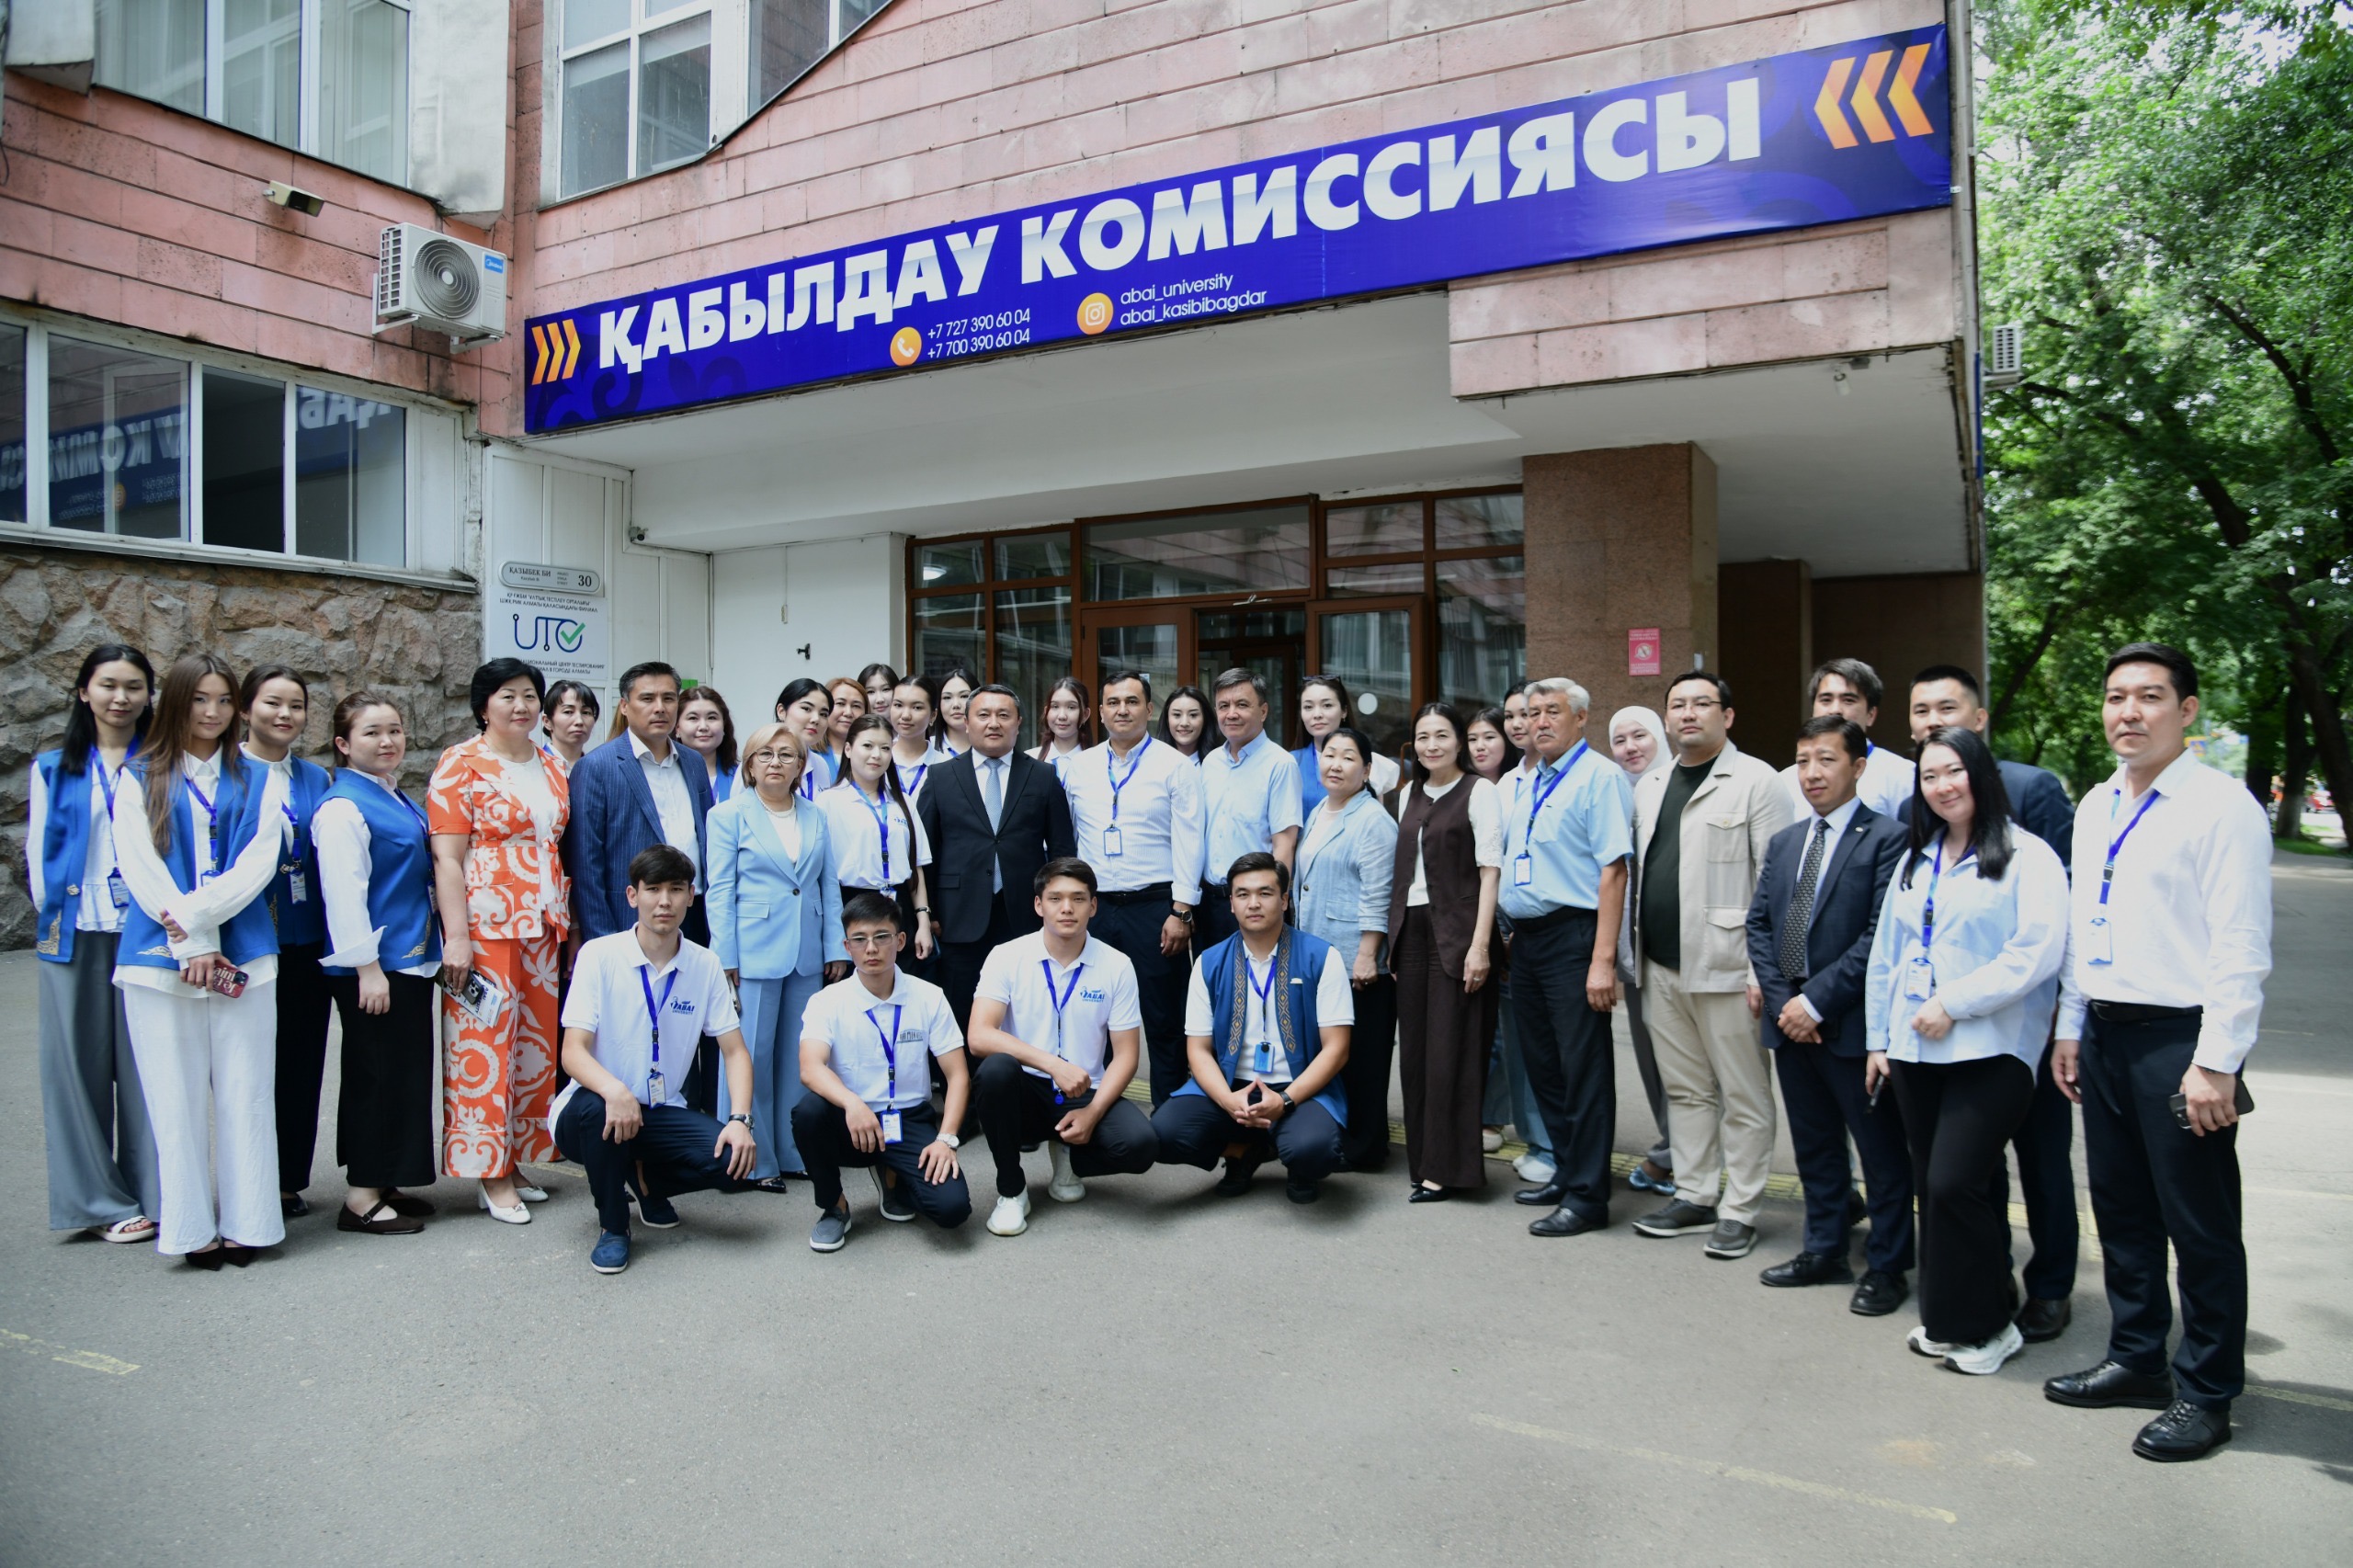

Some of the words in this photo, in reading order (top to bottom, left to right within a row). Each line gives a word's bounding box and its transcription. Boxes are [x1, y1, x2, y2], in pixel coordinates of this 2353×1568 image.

[598, 224, 1000, 374] ҚАБЫЛДАУ
[1020, 77, 1762, 285] КОМИССИЯСЫ
[1120, 273, 1233, 305] abai_university
[927, 324, 943, 339] +7
[946, 318, 968, 337] 727
[971, 314, 994, 333] 390
[995, 311, 1012, 328] 60
[1014, 307, 1030, 325] 04
[1120, 290, 1267, 325] abai_kasibibagdar
[927, 343, 943, 358] +7
[946, 338, 968, 357] 700
[971, 335, 994, 352] 390
[995, 331, 1012, 347] 60
[1014, 327, 1030, 345] 04
[541, 569, 551, 577] БИ
[578, 574, 592, 587] 30
